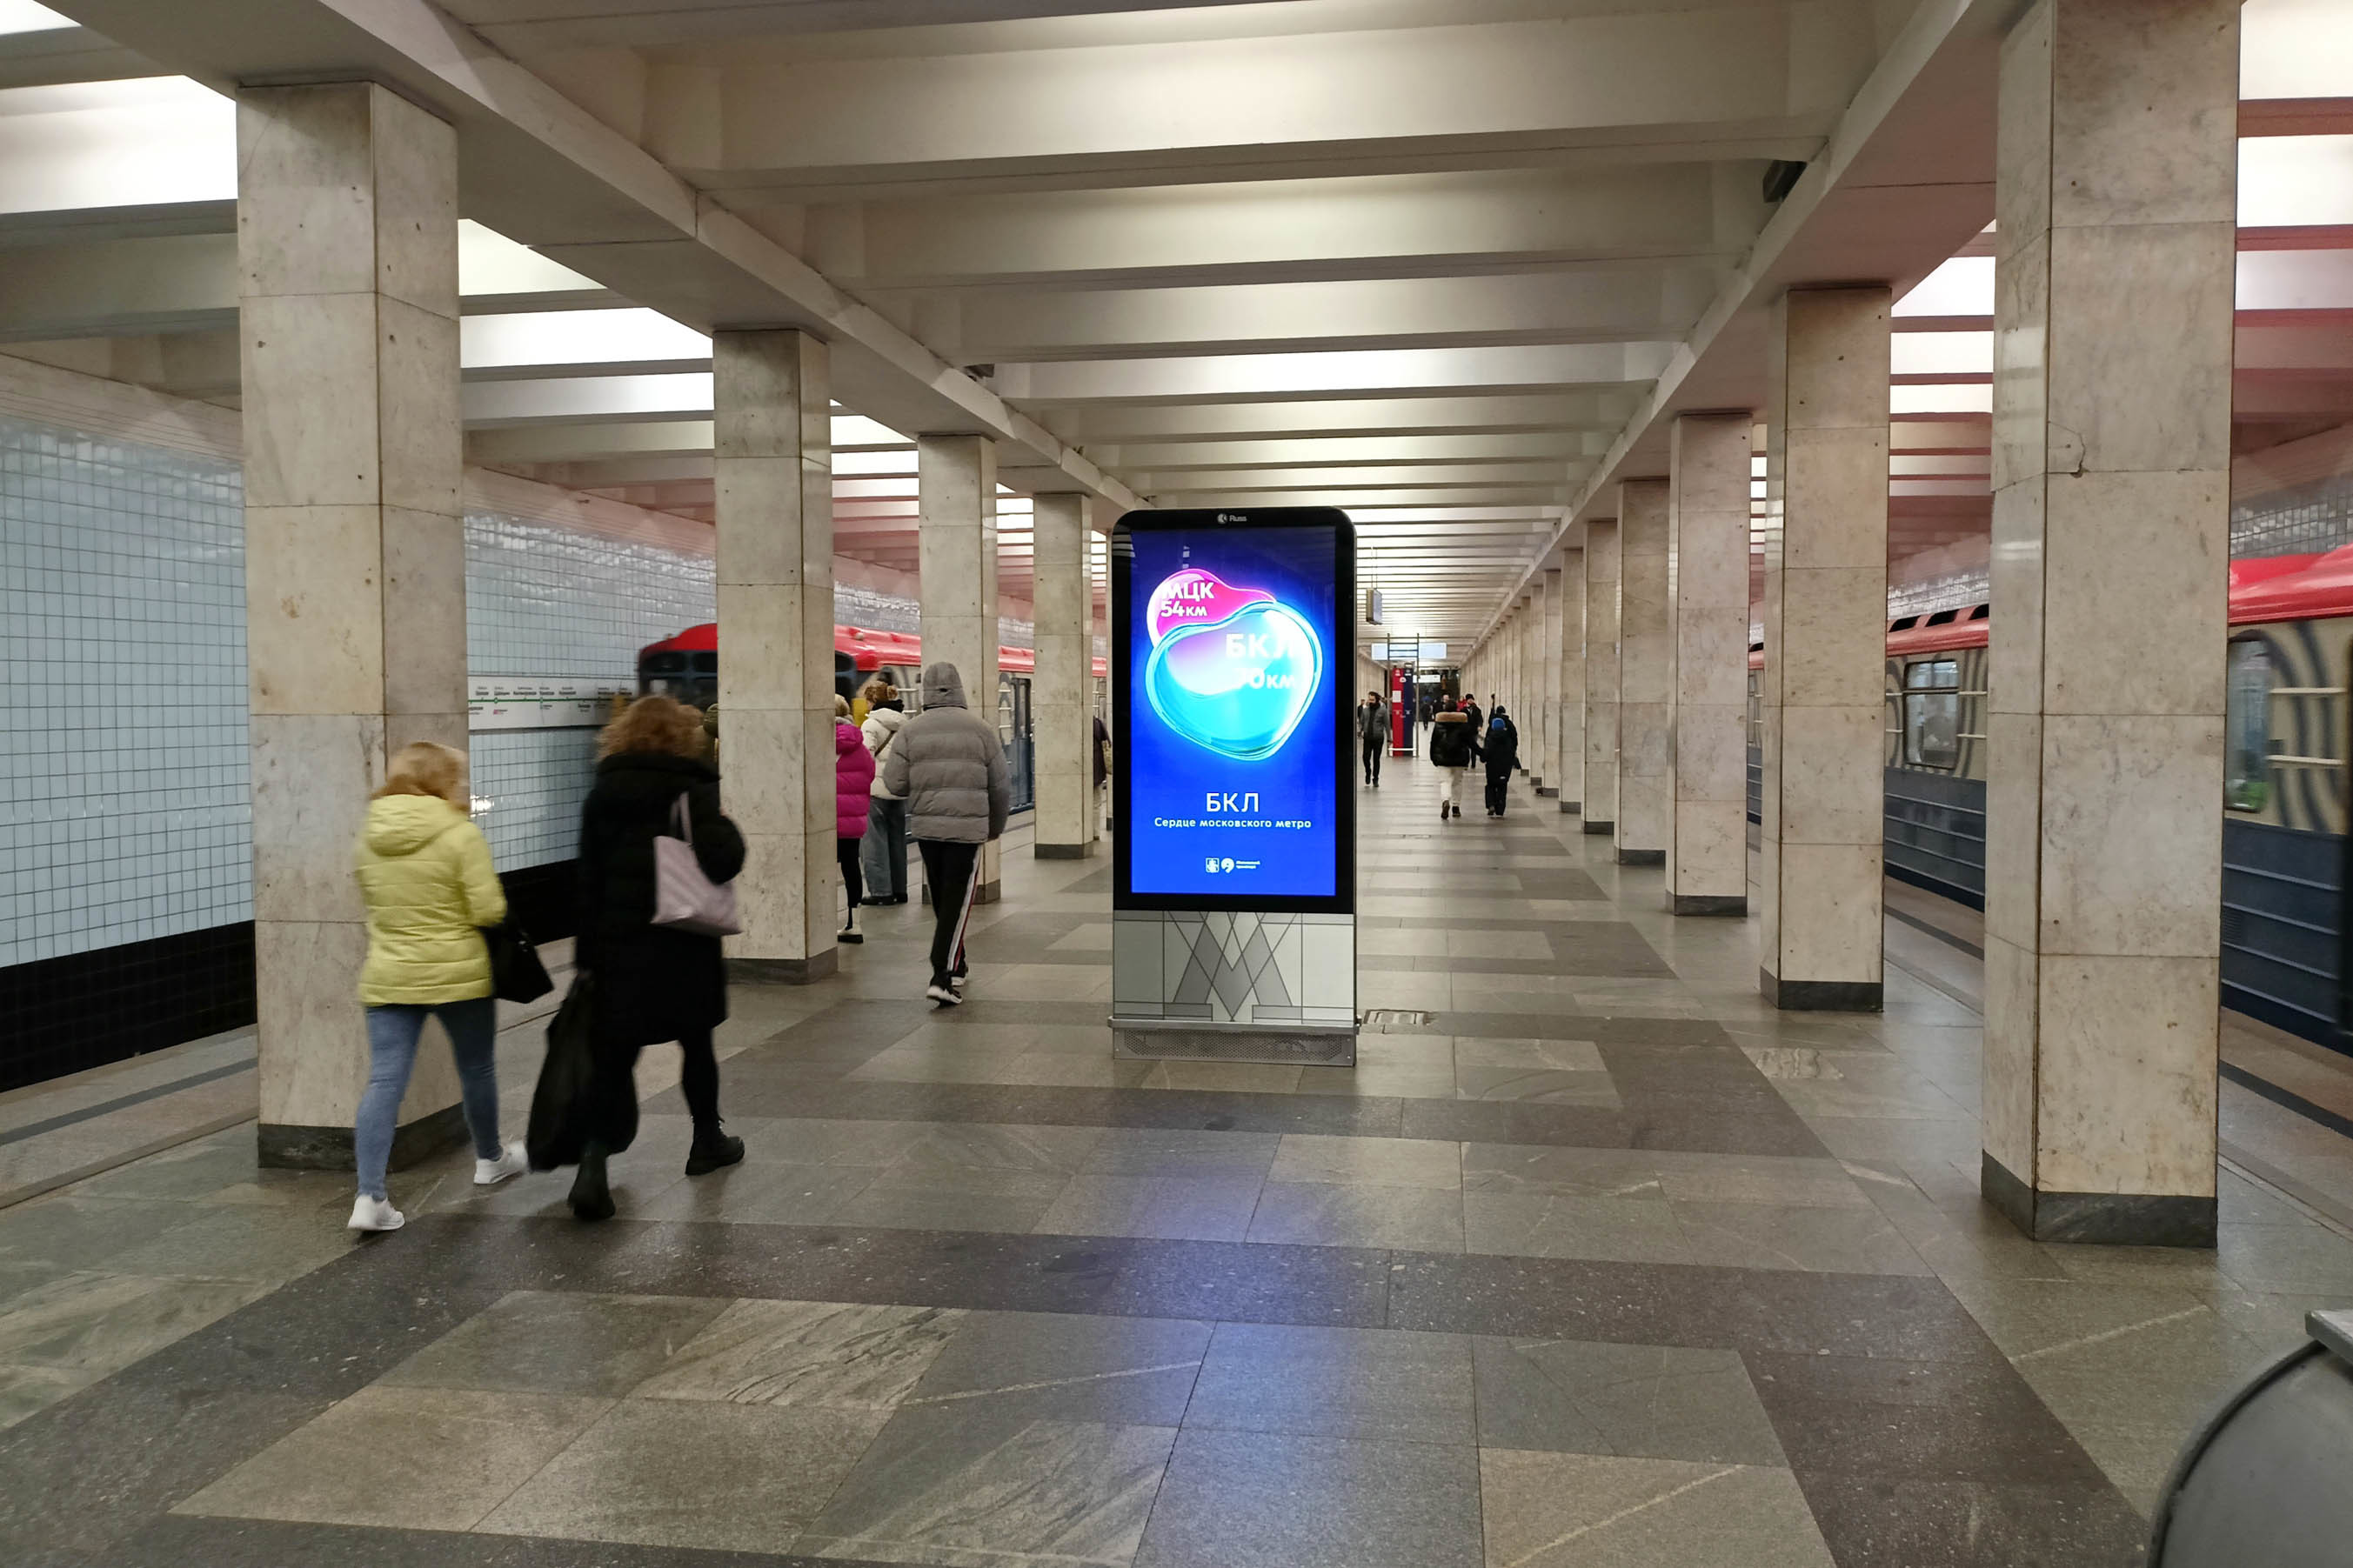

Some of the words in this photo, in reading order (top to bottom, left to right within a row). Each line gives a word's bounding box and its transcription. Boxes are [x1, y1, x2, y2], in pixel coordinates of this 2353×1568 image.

[1162, 582, 1215, 603] МЦК
[1206, 792, 1259, 813] БКЛ
[1154, 817, 1196, 829] Сердце
[1199, 818, 1273, 829] московского
[1275, 820, 1312, 830] метро
